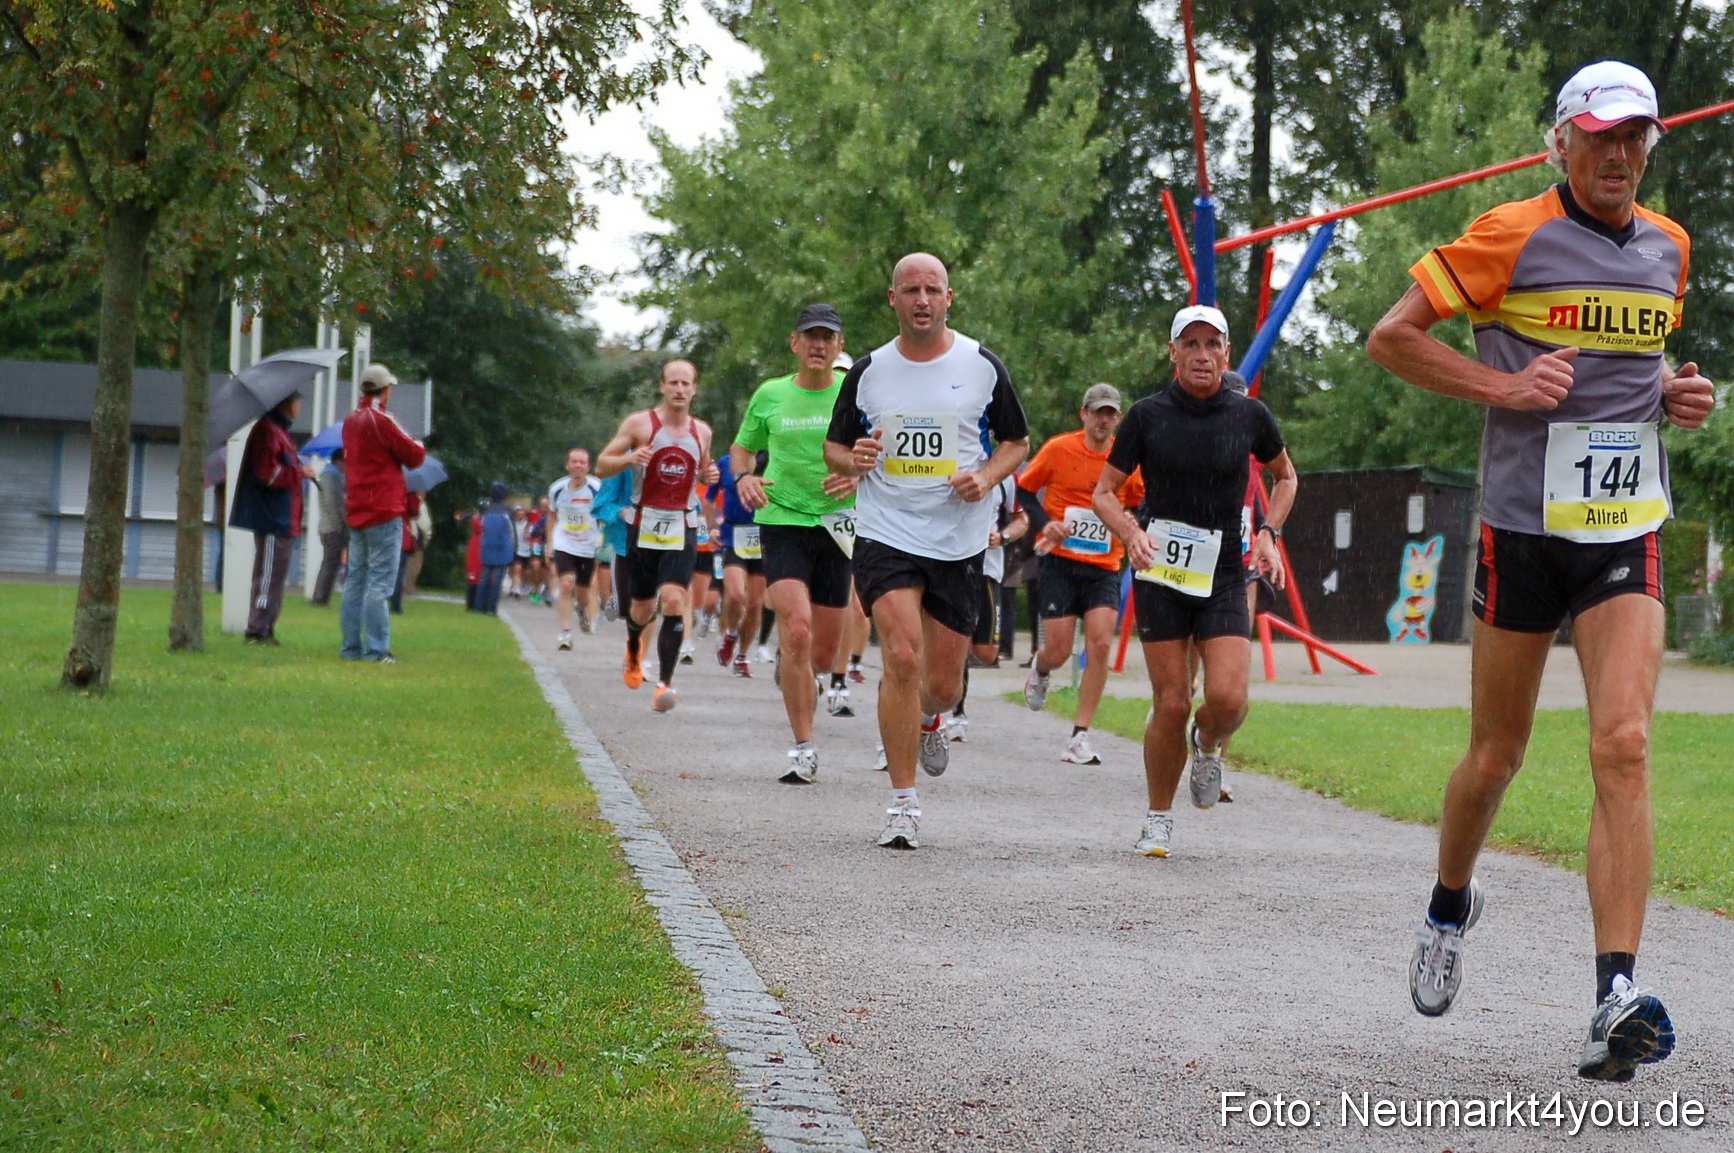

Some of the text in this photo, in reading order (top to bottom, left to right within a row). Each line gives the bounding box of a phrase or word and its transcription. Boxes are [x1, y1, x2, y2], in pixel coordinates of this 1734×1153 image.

[1547, 297, 1667, 337] MÜLLER
[1597, 335, 1633, 345] Präzision
[896, 431, 943, 457] 209
[1589, 431, 1636, 442] BOCK
[661, 463, 684, 475] LAC
[902, 463, 935, 474] Lothar
[1575, 455, 1641, 498] 144
[652, 521, 671, 535] 47
[1070, 520, 1107, 541] 3229
[1166, 540, 1193, 568] 91
